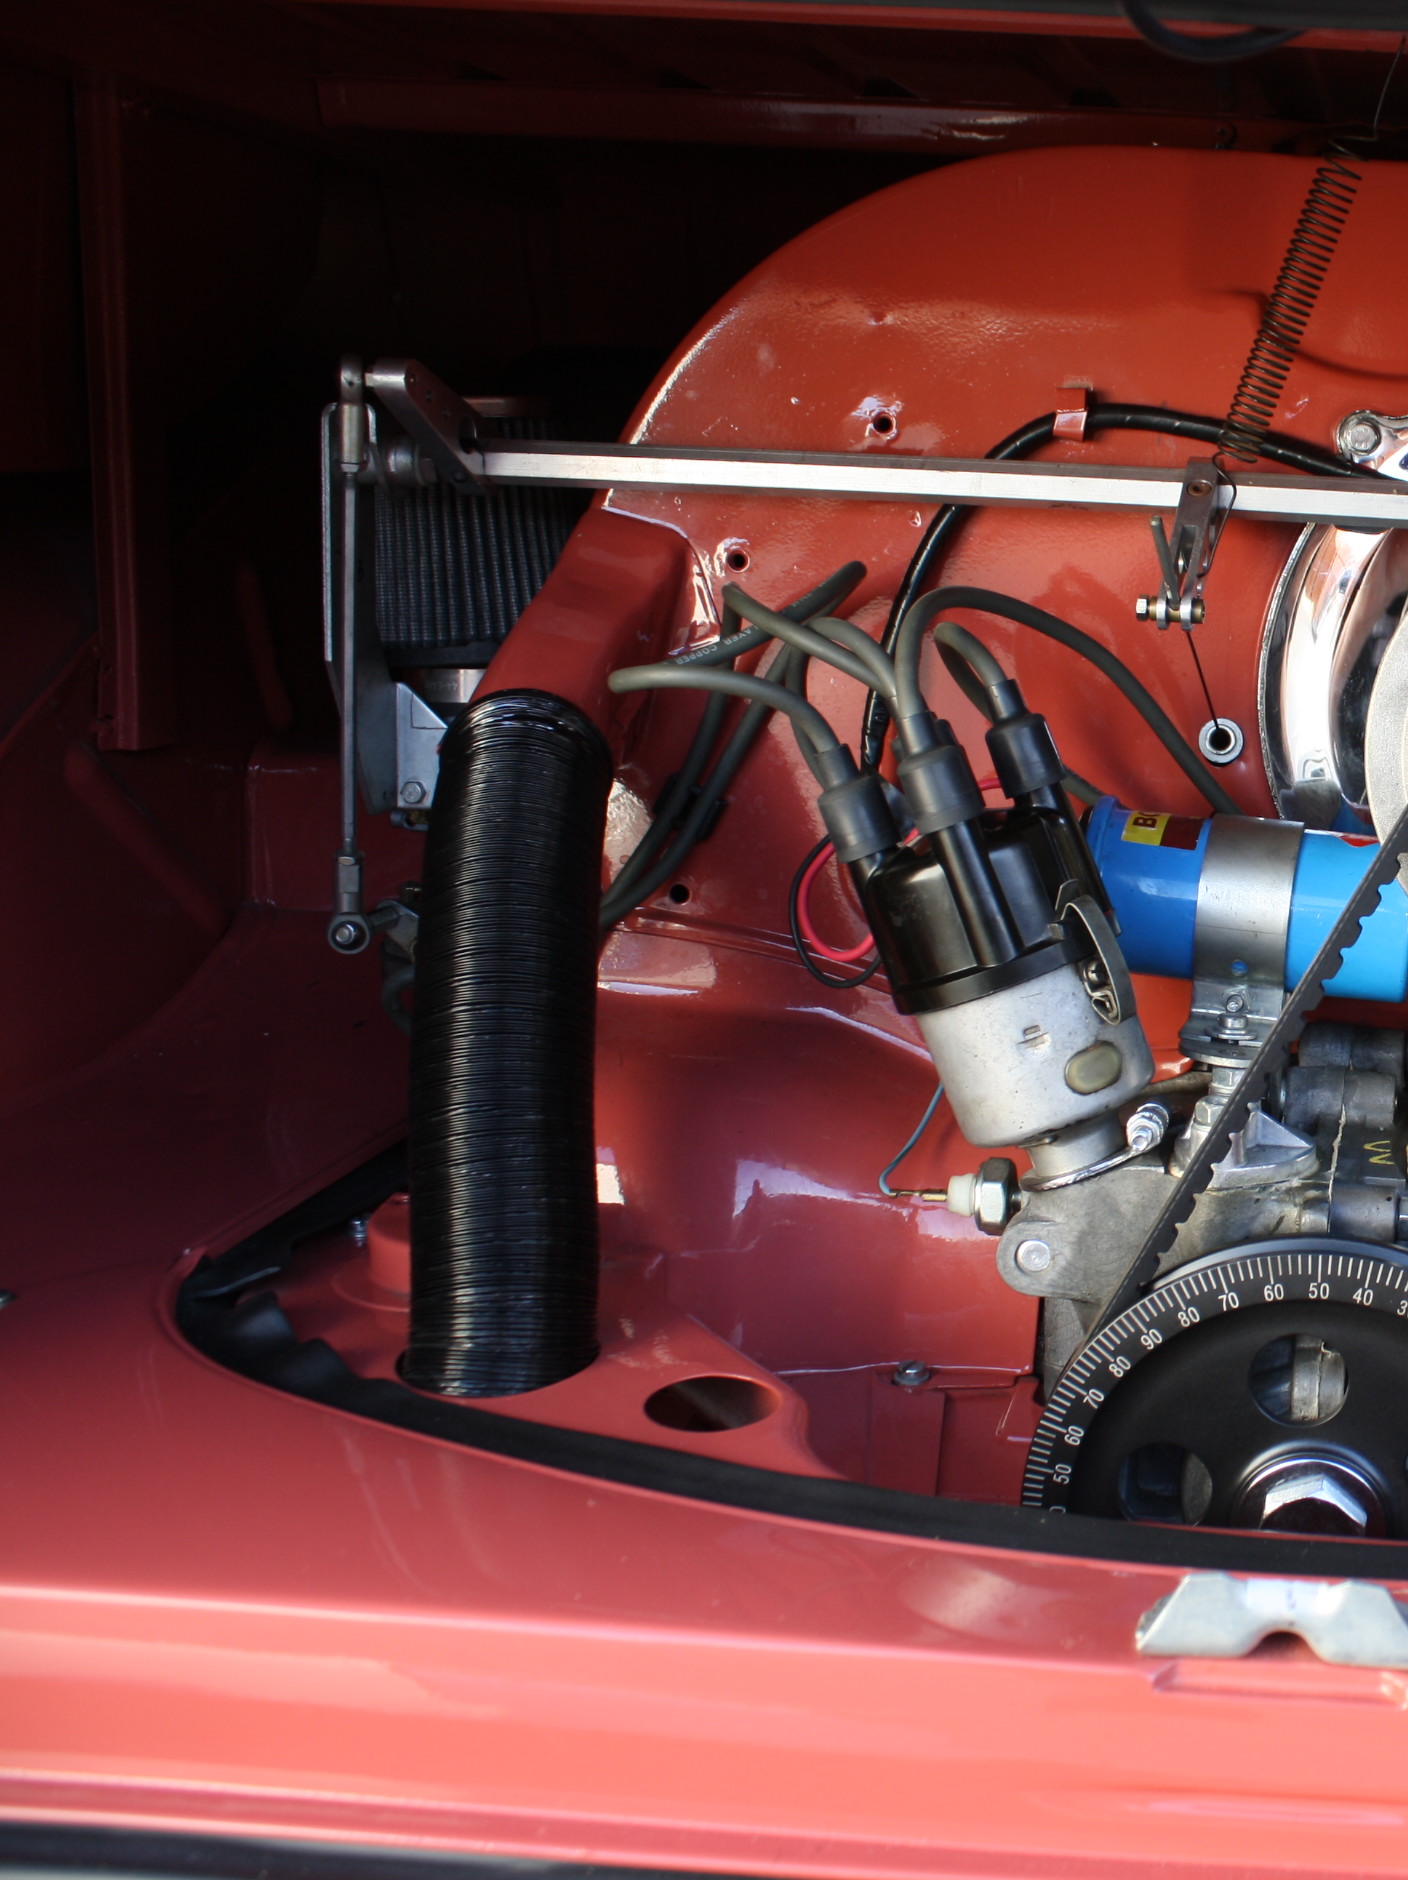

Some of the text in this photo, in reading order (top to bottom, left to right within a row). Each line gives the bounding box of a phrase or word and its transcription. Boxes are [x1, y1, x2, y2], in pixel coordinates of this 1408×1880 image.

[675, 644, 718, 666] COPPER
[1218, 1292, 1240, 1311] 70
[1263, 1284, 1284, 1301] 60
[1308, 1283, 1330, 1300] 50
[1352, 1288, 1374, 1306] 40
[1177, 1307, 1200, 1327] 80
[1140, 1328, 1163, 1350] 90
[1108, 1355, 1131, 1378] 80
[1083, 1388, 1105, 1409] 70
[1064, 1425, 1085, 1446] 60
[1053, 1463, 1072, 1485] 50
